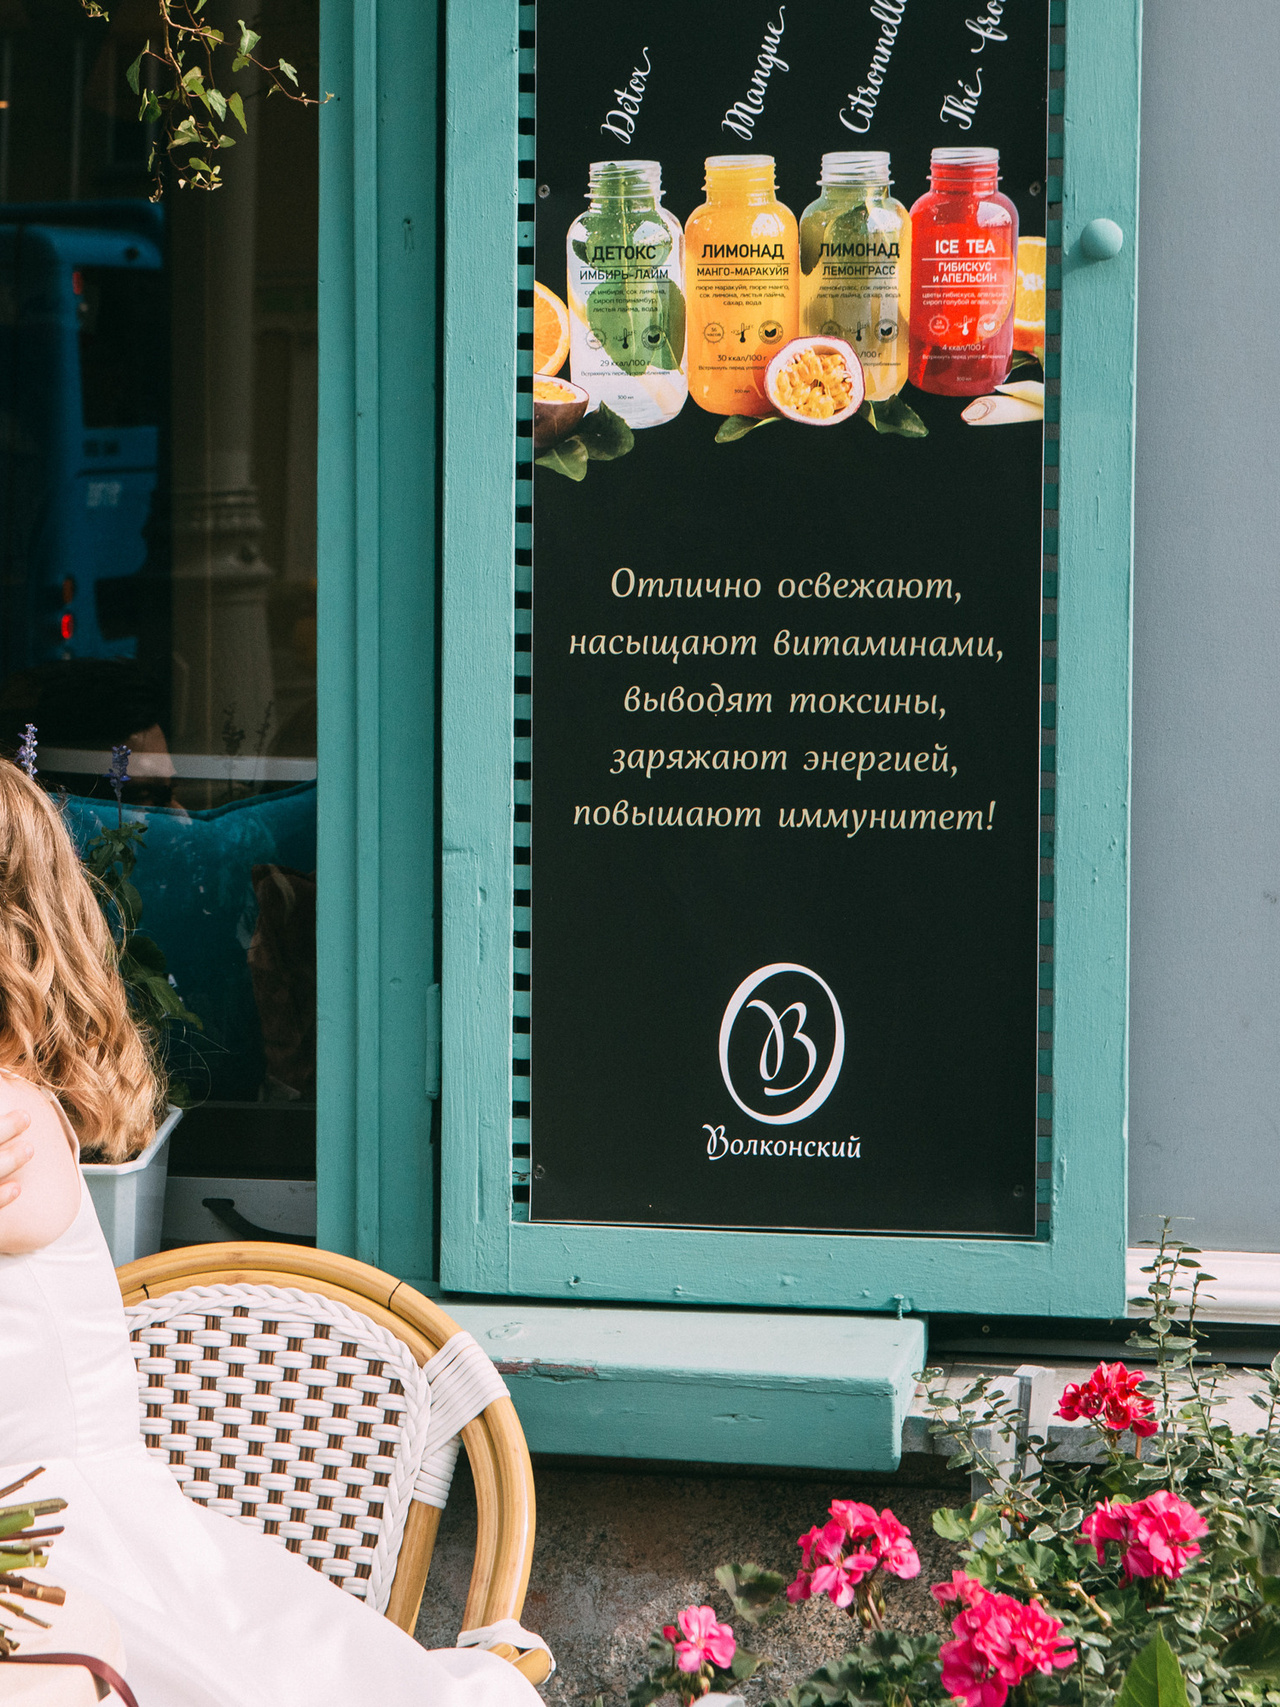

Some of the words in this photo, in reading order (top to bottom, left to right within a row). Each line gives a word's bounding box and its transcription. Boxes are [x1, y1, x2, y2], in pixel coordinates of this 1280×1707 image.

[721, 6, 789, 140] Mangue
[839, 0, 907, 133] Citronnell
[940, 68, 982, 130] Thé
[965, 0, 1008, 53] fro
[592, 245, 656, 263] ДЕТОКС
[702, 244, 785, 260] ЛИМОНАД
[819, 243, 900, 258] ЛИМОНАД
[936, 240, 959, 254] ICE
[966, 239, 995, 254] TEA
[580, 266, 669, 280] ИМБИРЬ-ЛАЙМ
[697, 265, 789, 276] МАНГО-МАРАКУЙЯ
[823, 266, 896, 276] ЛЕМОНГРАСС
[939, 262, 992, 272] ГИБИСКУС
[941, 273, 997, 283] АПЕЛЬСИН
[612, 568, 761, 598] Отлично
[778, 572, 961, 604] освежают,
[570, 635, 756, 664] насыщают
[774, 629, 1003, 662] витаминами,
[624, 683, 772, 716] выводят
[790, 694, 945, 720] токсины,
[610, 749, 787, 778] заряжают
[803, 743, 957, 781] энергией,
[574, 800, 760, 827] повышают
[779, 801, 996, 838] иммунитет!
[702, 1123, 861, 1161] Волконский
